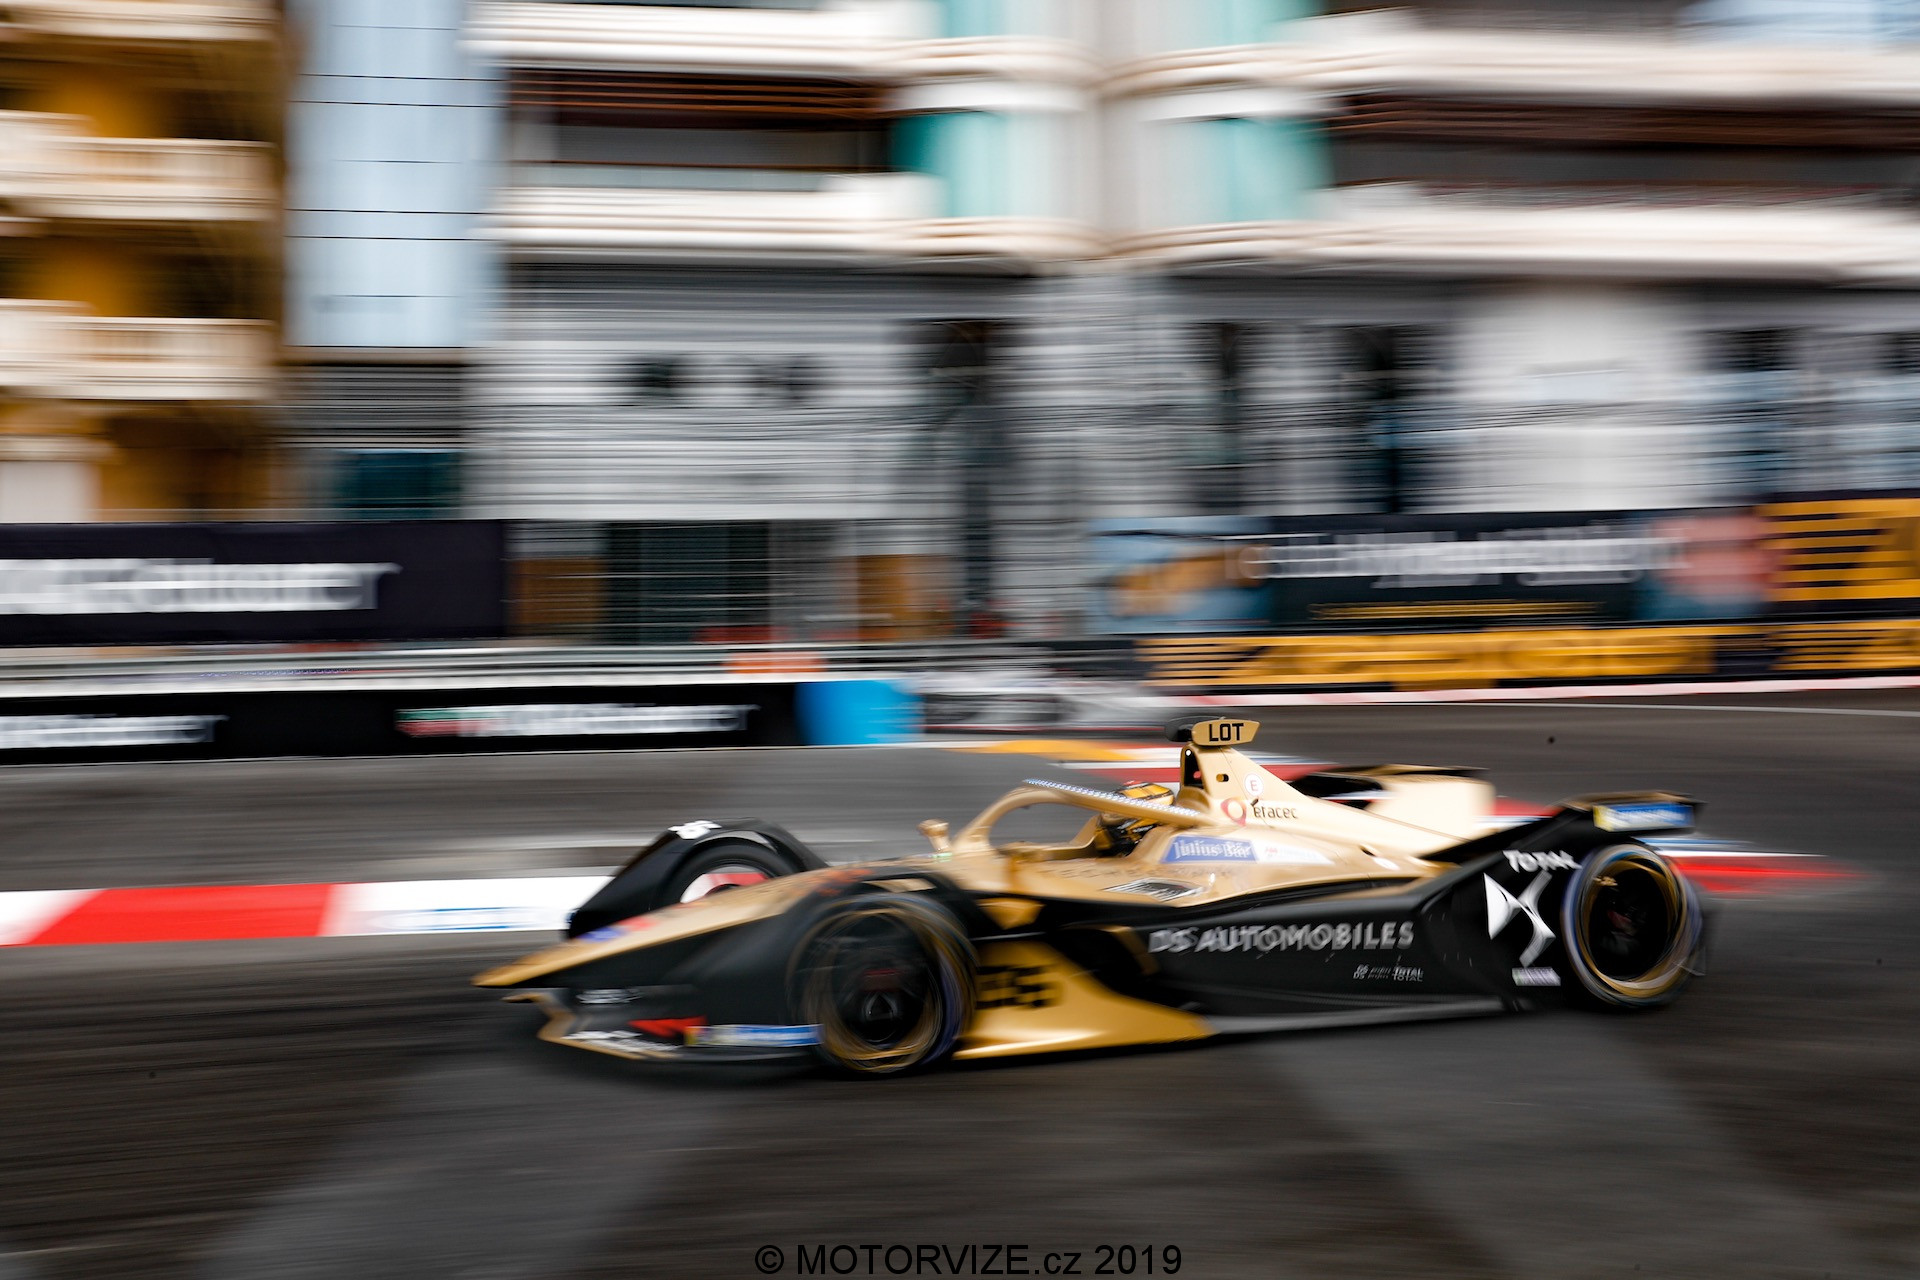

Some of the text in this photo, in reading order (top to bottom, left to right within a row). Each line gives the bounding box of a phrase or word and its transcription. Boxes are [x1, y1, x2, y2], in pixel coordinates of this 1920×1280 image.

[1209, 723, 1244, 742] LOT
[1250, 780, 1259, 791] E
[1173, 840, 1219, 859] Julius
[1148, 921, 1414, 953] DS AUTOMOBILES
